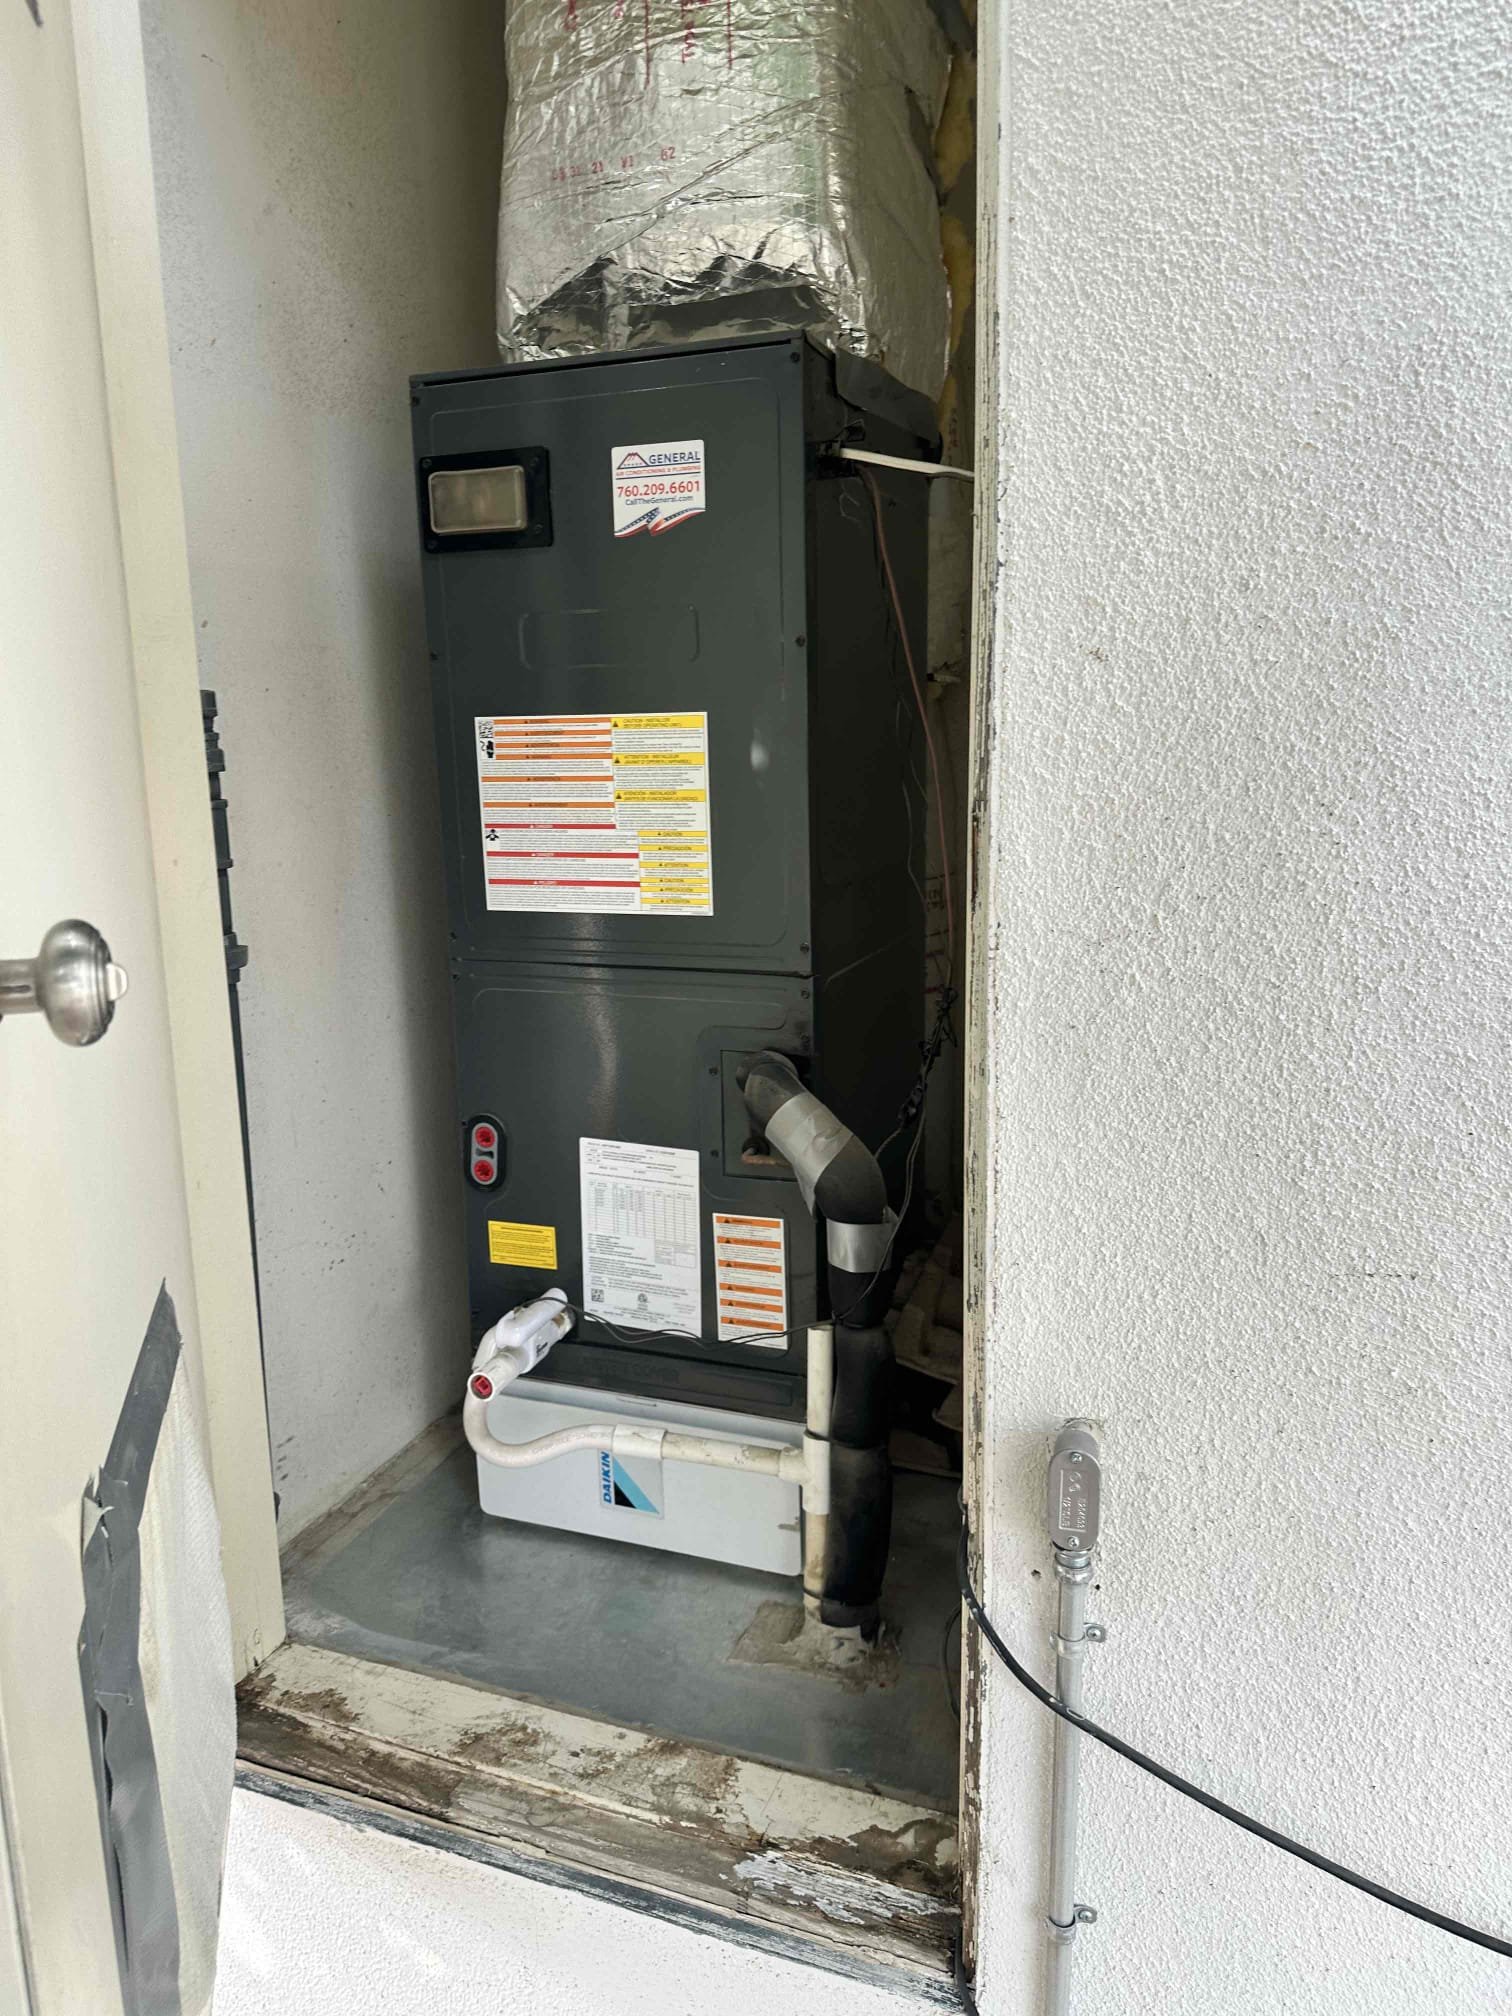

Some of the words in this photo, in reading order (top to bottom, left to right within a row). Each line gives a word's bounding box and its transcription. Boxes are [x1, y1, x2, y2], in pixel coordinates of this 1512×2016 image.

[648, 451, 701, 464] GENERAL
[625, 467, 666, 476] CONDITIONING
[616, 480, 700, 497] 760.209.6601
[625, 496, 694, 506] CallTheGeneral.com
[600, 1451, 612, 1504] DAIKIN
